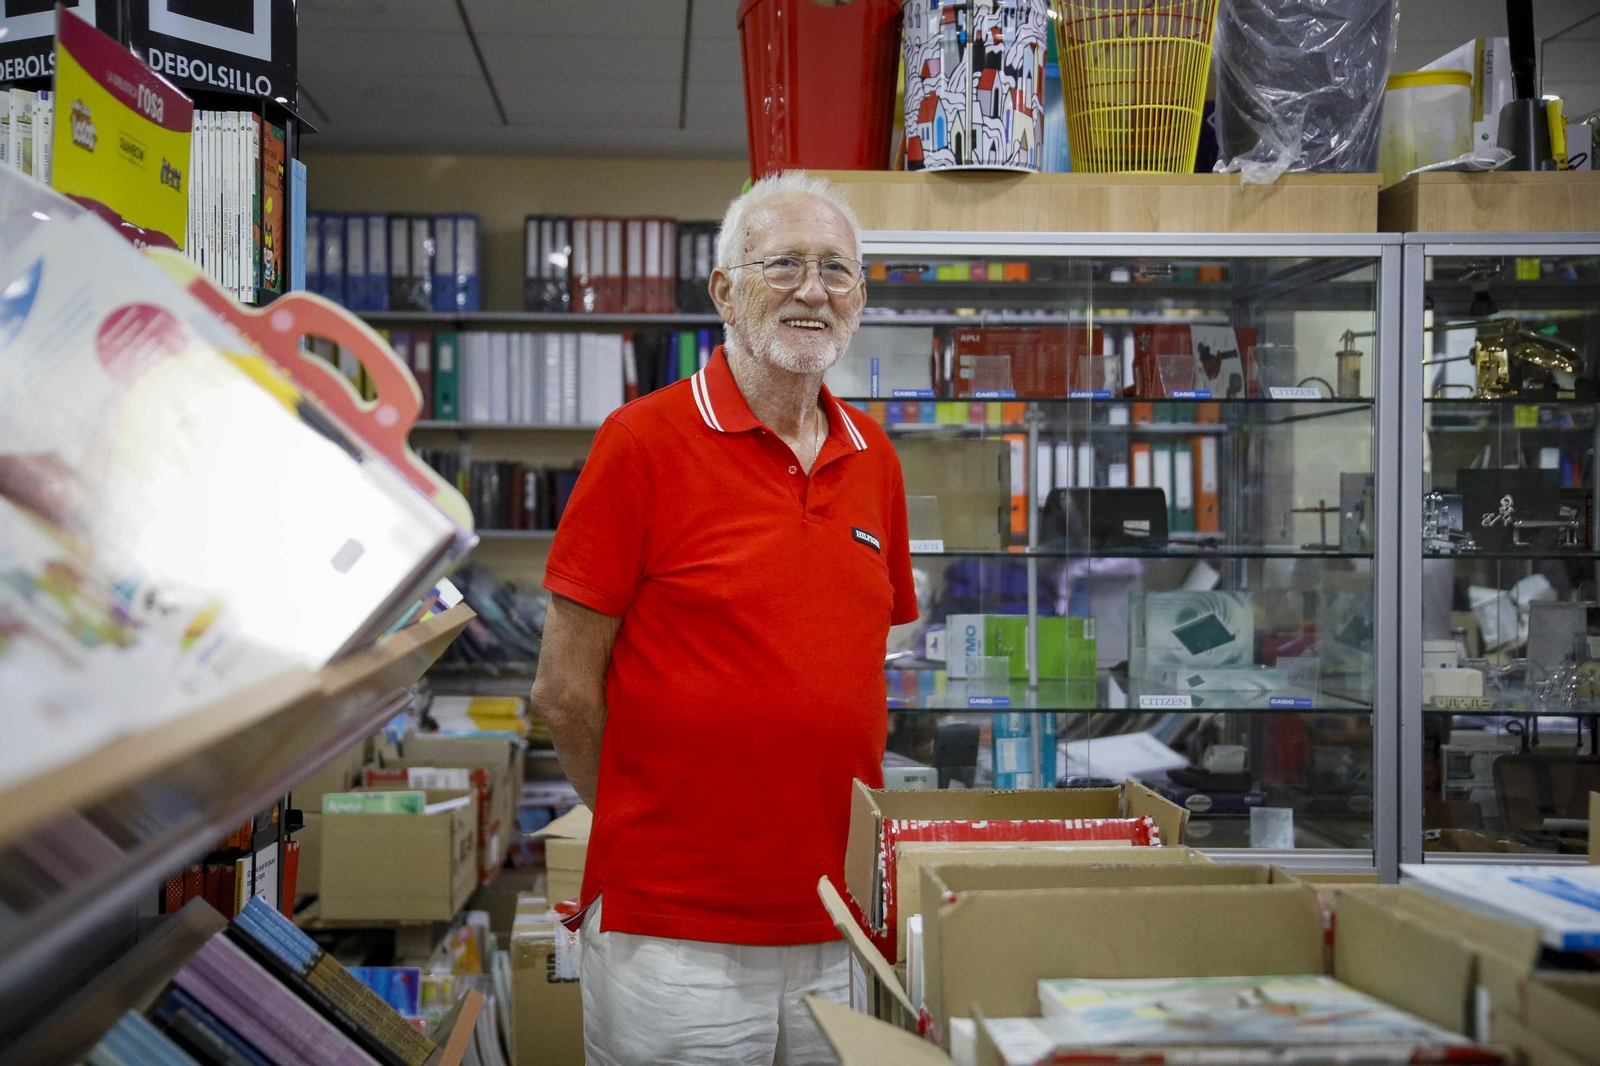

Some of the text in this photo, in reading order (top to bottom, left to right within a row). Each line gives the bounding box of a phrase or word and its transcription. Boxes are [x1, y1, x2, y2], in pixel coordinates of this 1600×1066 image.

[1486, 49, 1494, 75] M-673
[138, 83, 164, 123] rosa
[959, 334, 980, 342] APLI
[1272, 388, 1316, 397] CITIZEN
[1141, 697, 1187, 706] CITIZEN
